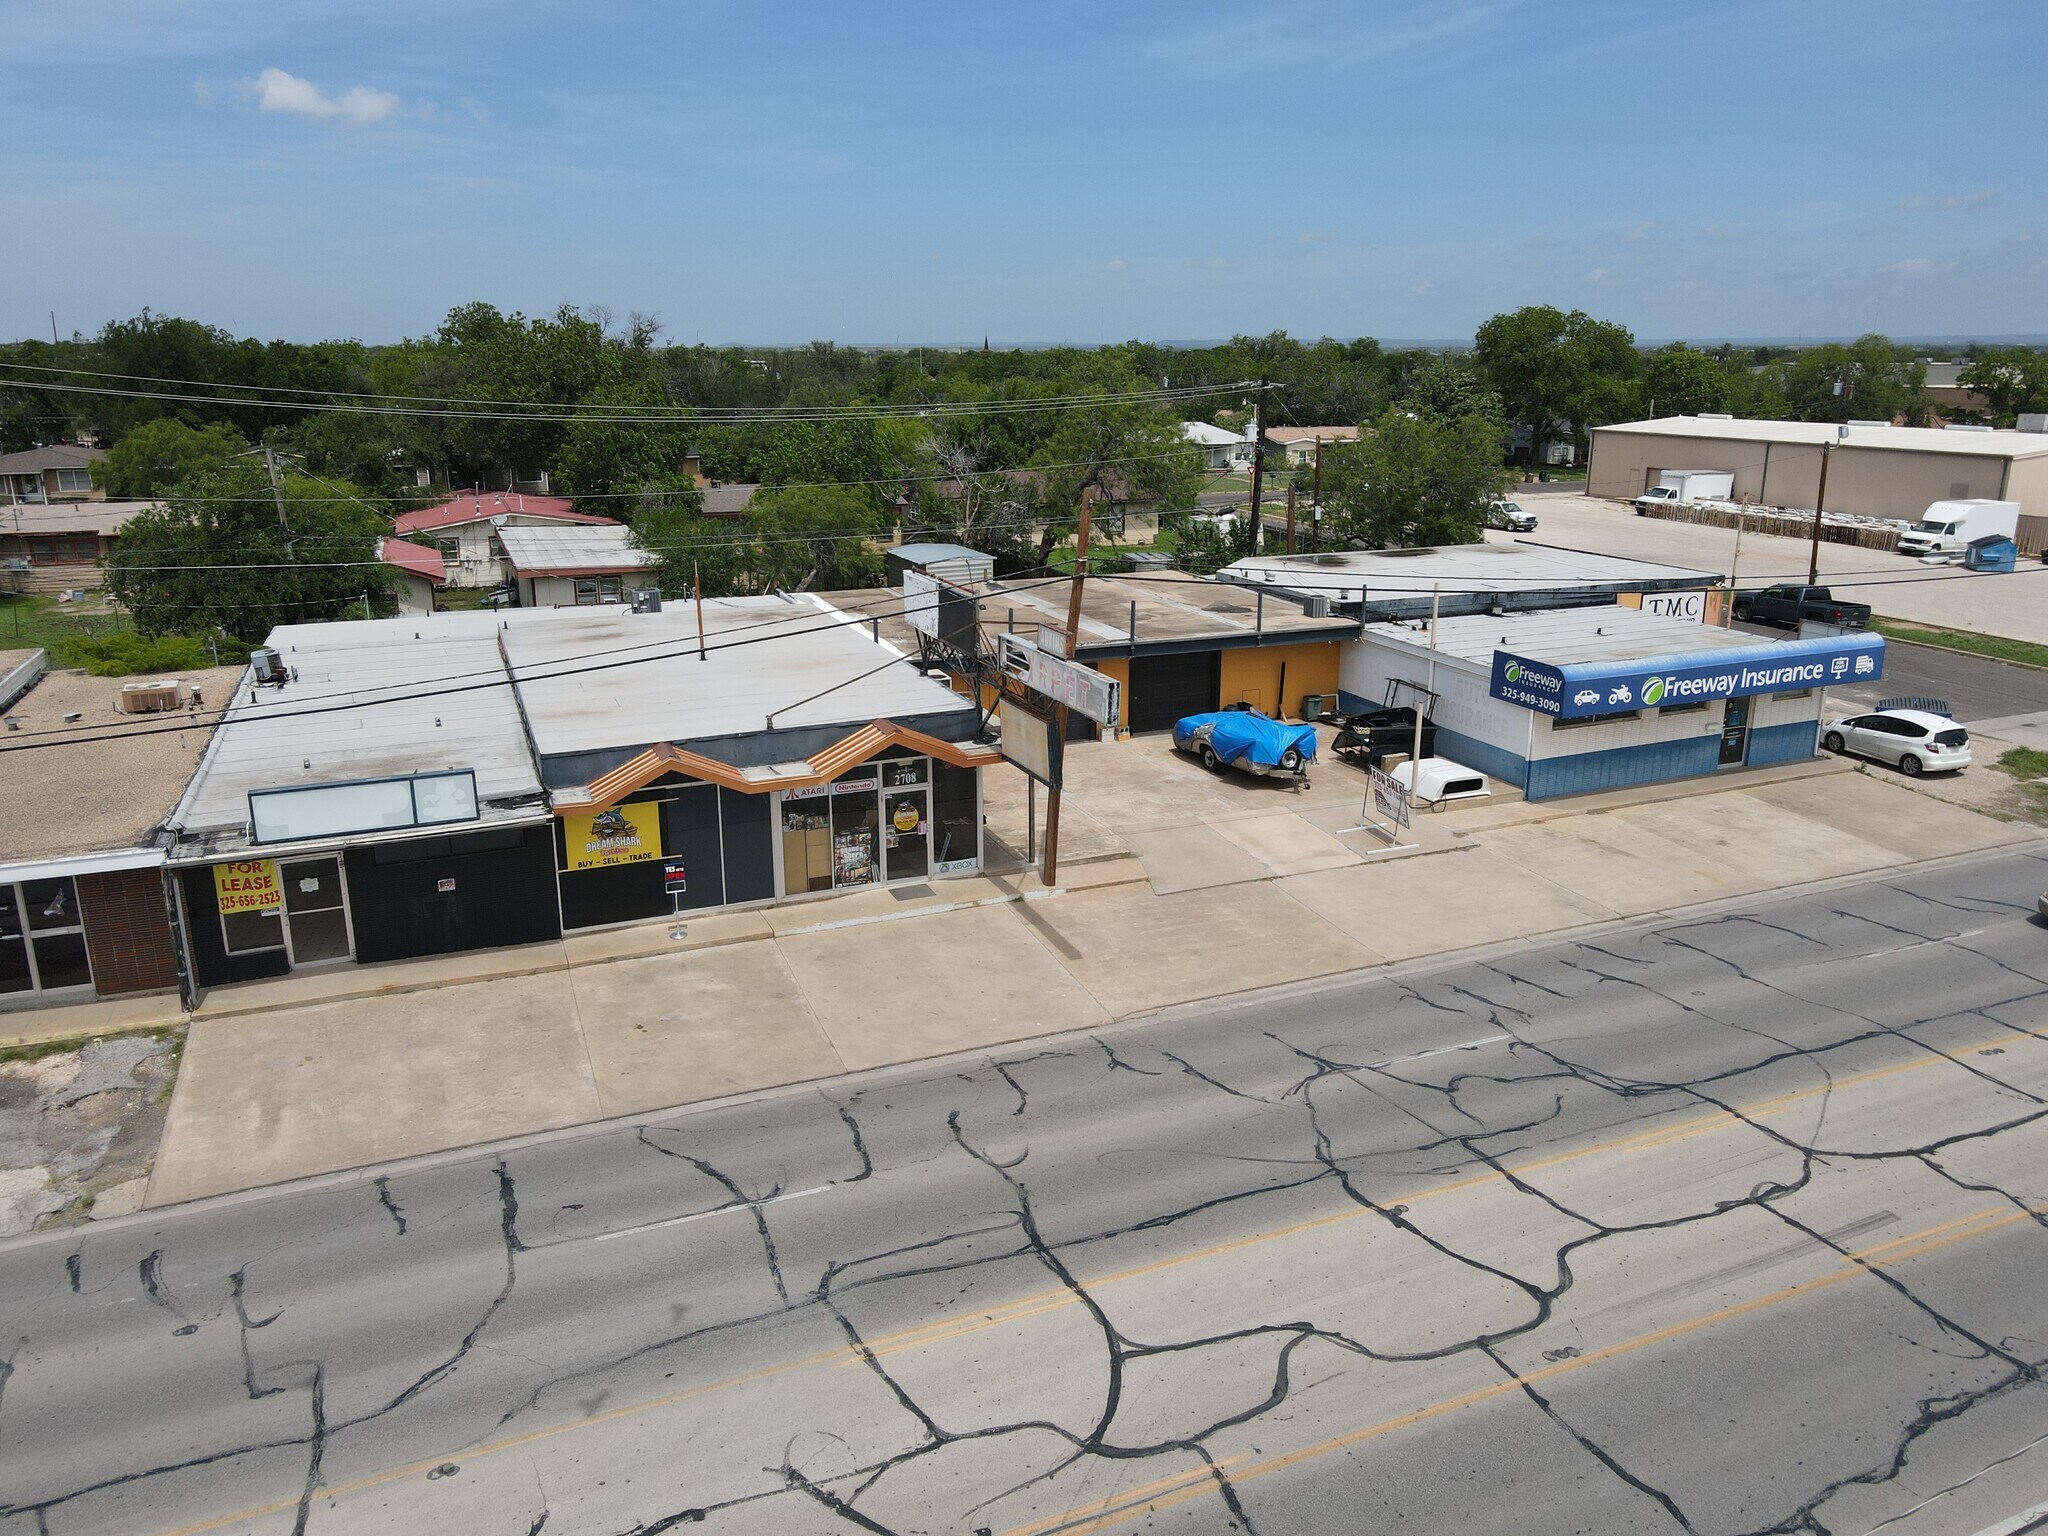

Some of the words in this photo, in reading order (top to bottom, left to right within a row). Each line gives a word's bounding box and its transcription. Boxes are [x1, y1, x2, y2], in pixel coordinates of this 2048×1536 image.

[1649, 596, 1699, 617] TMC
[1018, 655, 1091, 709] ARPET
[1518, 679, 1555, 693] INSURANCE
[1519, 666, 1562, 692] Freeway
[1664, 674, 1738, 695] Freeway
[1741, 664, 1823, 688] Insurance
[1502, 686, 1560, 712] 325-949-3090
[838, 782, 872, 791] Nintendo
[895, 772, 917, 785] 2708
[1373, 770, 1386, 785] FOR
[1387, 778, 1403, 795] SALE
[801, 787, 825, 796] ATARI
[586, 840, 614, 853] DREAM
[615, 836, 642, 847] SHARK
[227, 861, 263, 874] FOR
[578, 860, 594, 868] BUY
[603, 857, 620, 865] SELL
[629, 852, 653, 861] TRADE
[951, 860, 973, 870] XBOX
[221, 875, 273, 892] LEASE
[665, 872, 686, 881] OPEN
[220, 890, 281, 911] 325-656-2523
